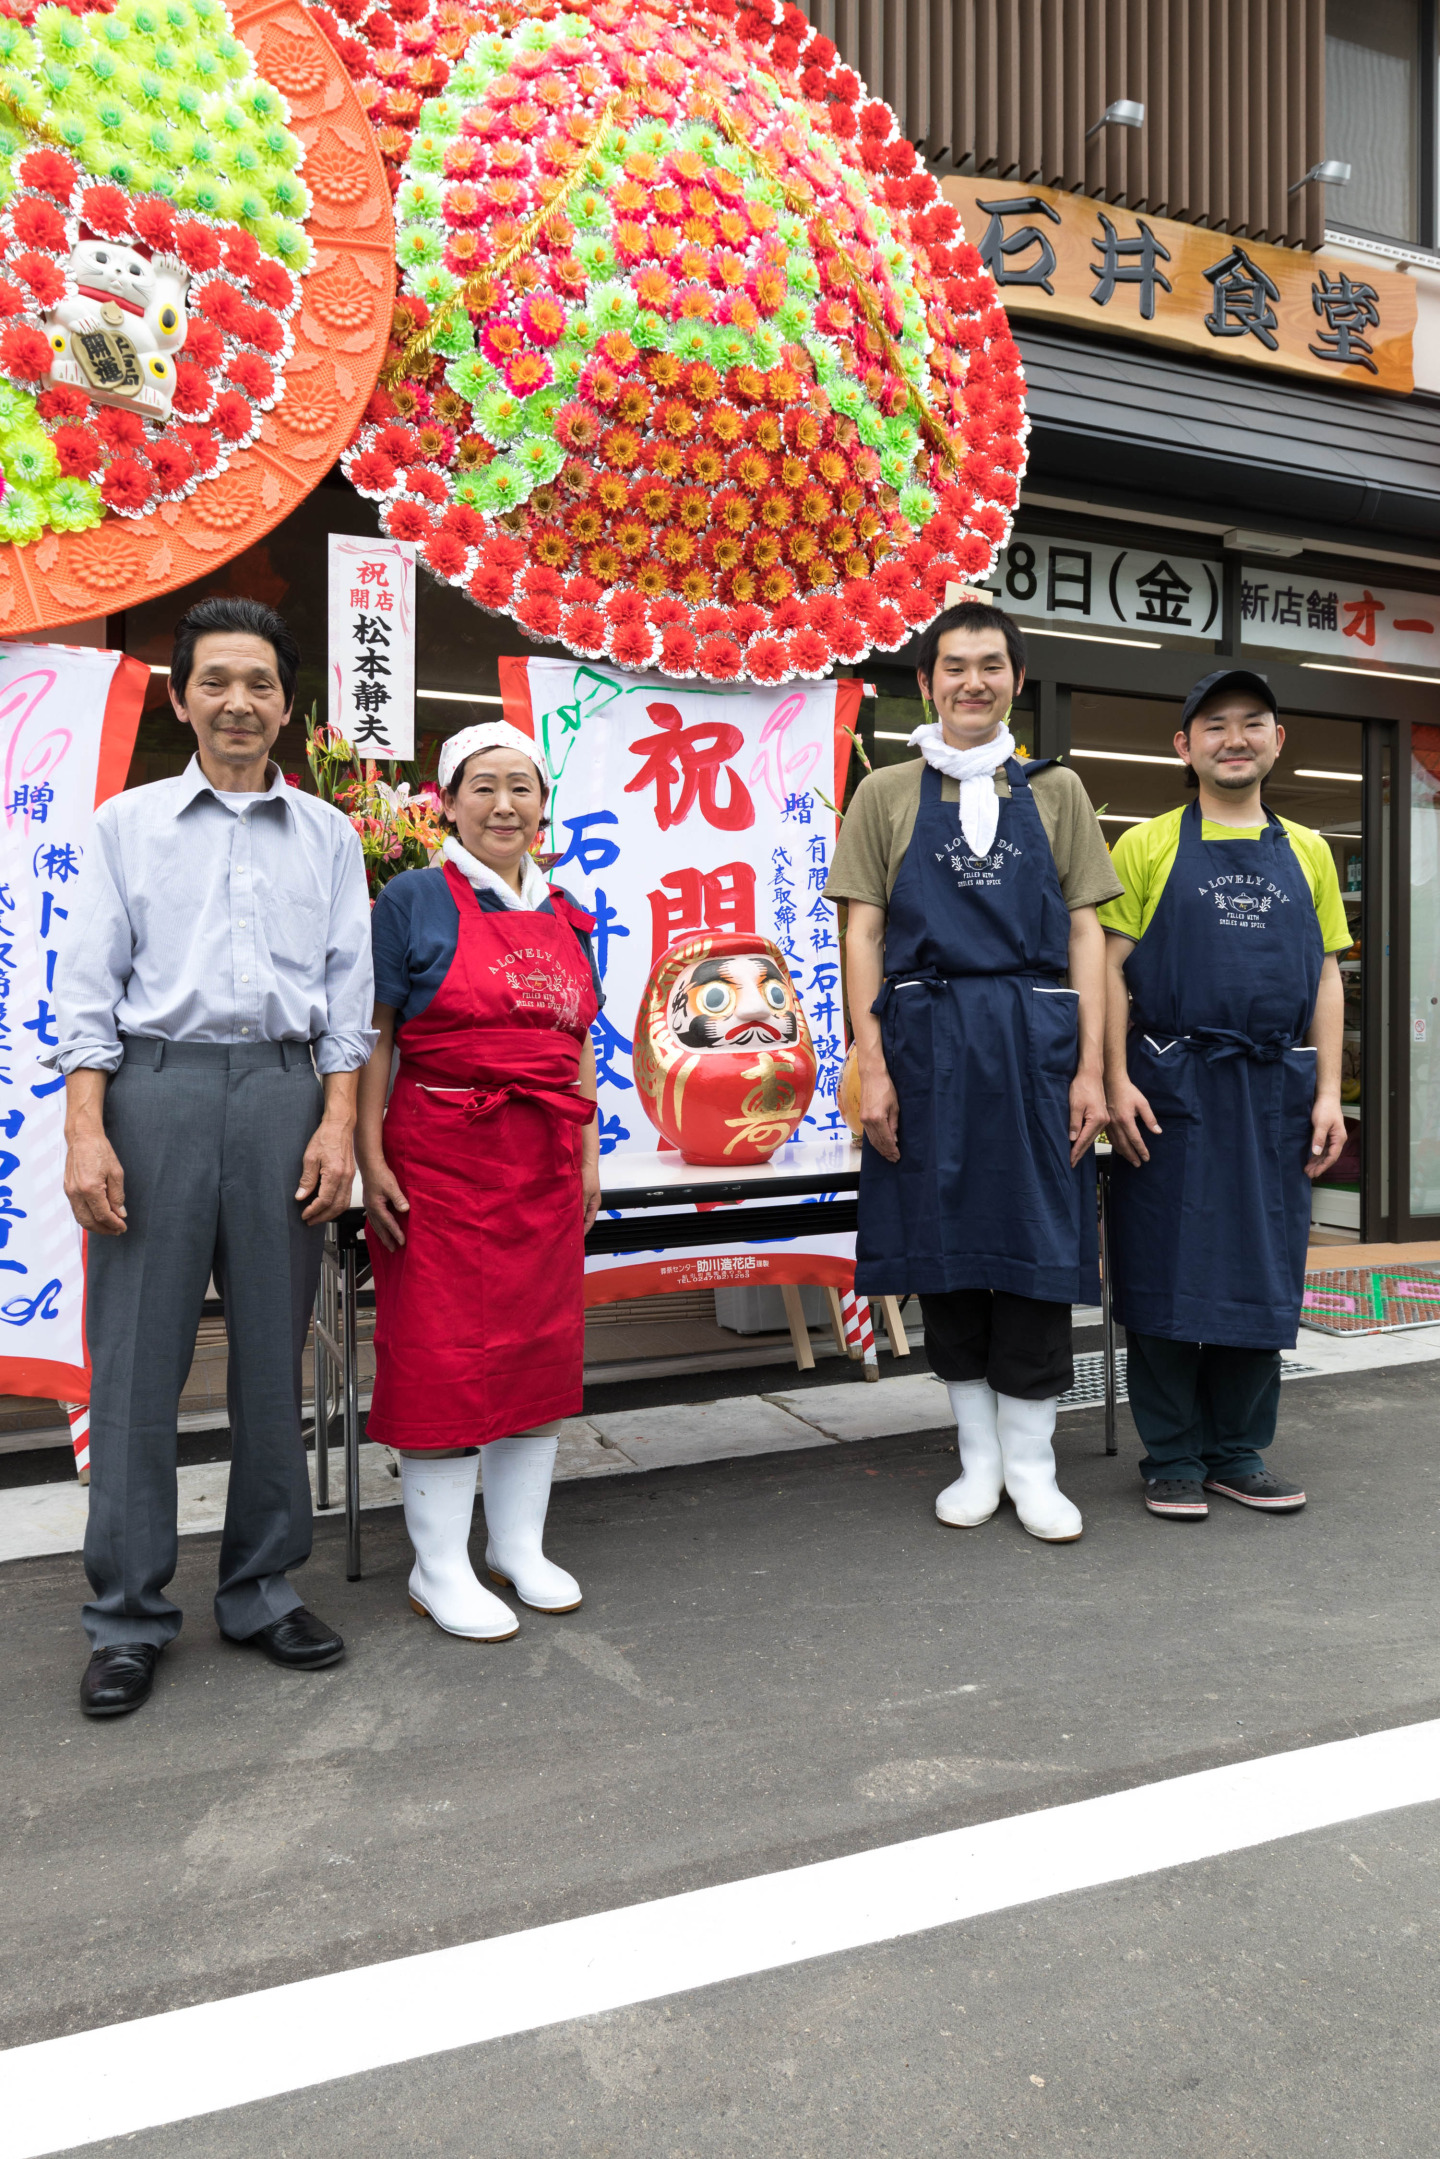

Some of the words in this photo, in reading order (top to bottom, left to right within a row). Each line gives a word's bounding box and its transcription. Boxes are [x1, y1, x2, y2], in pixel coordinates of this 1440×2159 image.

[975, 195, 1380, 375] 石井食堂
[356, 560, 390, 587] 祝
[972, 541, 1220, 633] 8日(金)
[349, 588, 395, 612] 開店
[351, 613, 393, 746] 松本静夫
[5, 781, 54, 824] 贈
[780, 792, 815, 824] 贈
[934, 852, 945, 862] A
[996, 838, 1022, 857] DAY
[963, 871, 980, 879] FILLED
[1197, 886, 1209, 896] A
[1207, 874, 1265, 889] LOVELY
[1266, 882, 1290, 904] DAY
[1226, 912, 1245, 920] FILLED
[488, 965, 499, 975] A
[496, 948, 553, 968] LOVELY
[522, 992, 541, 1000] FILLED
